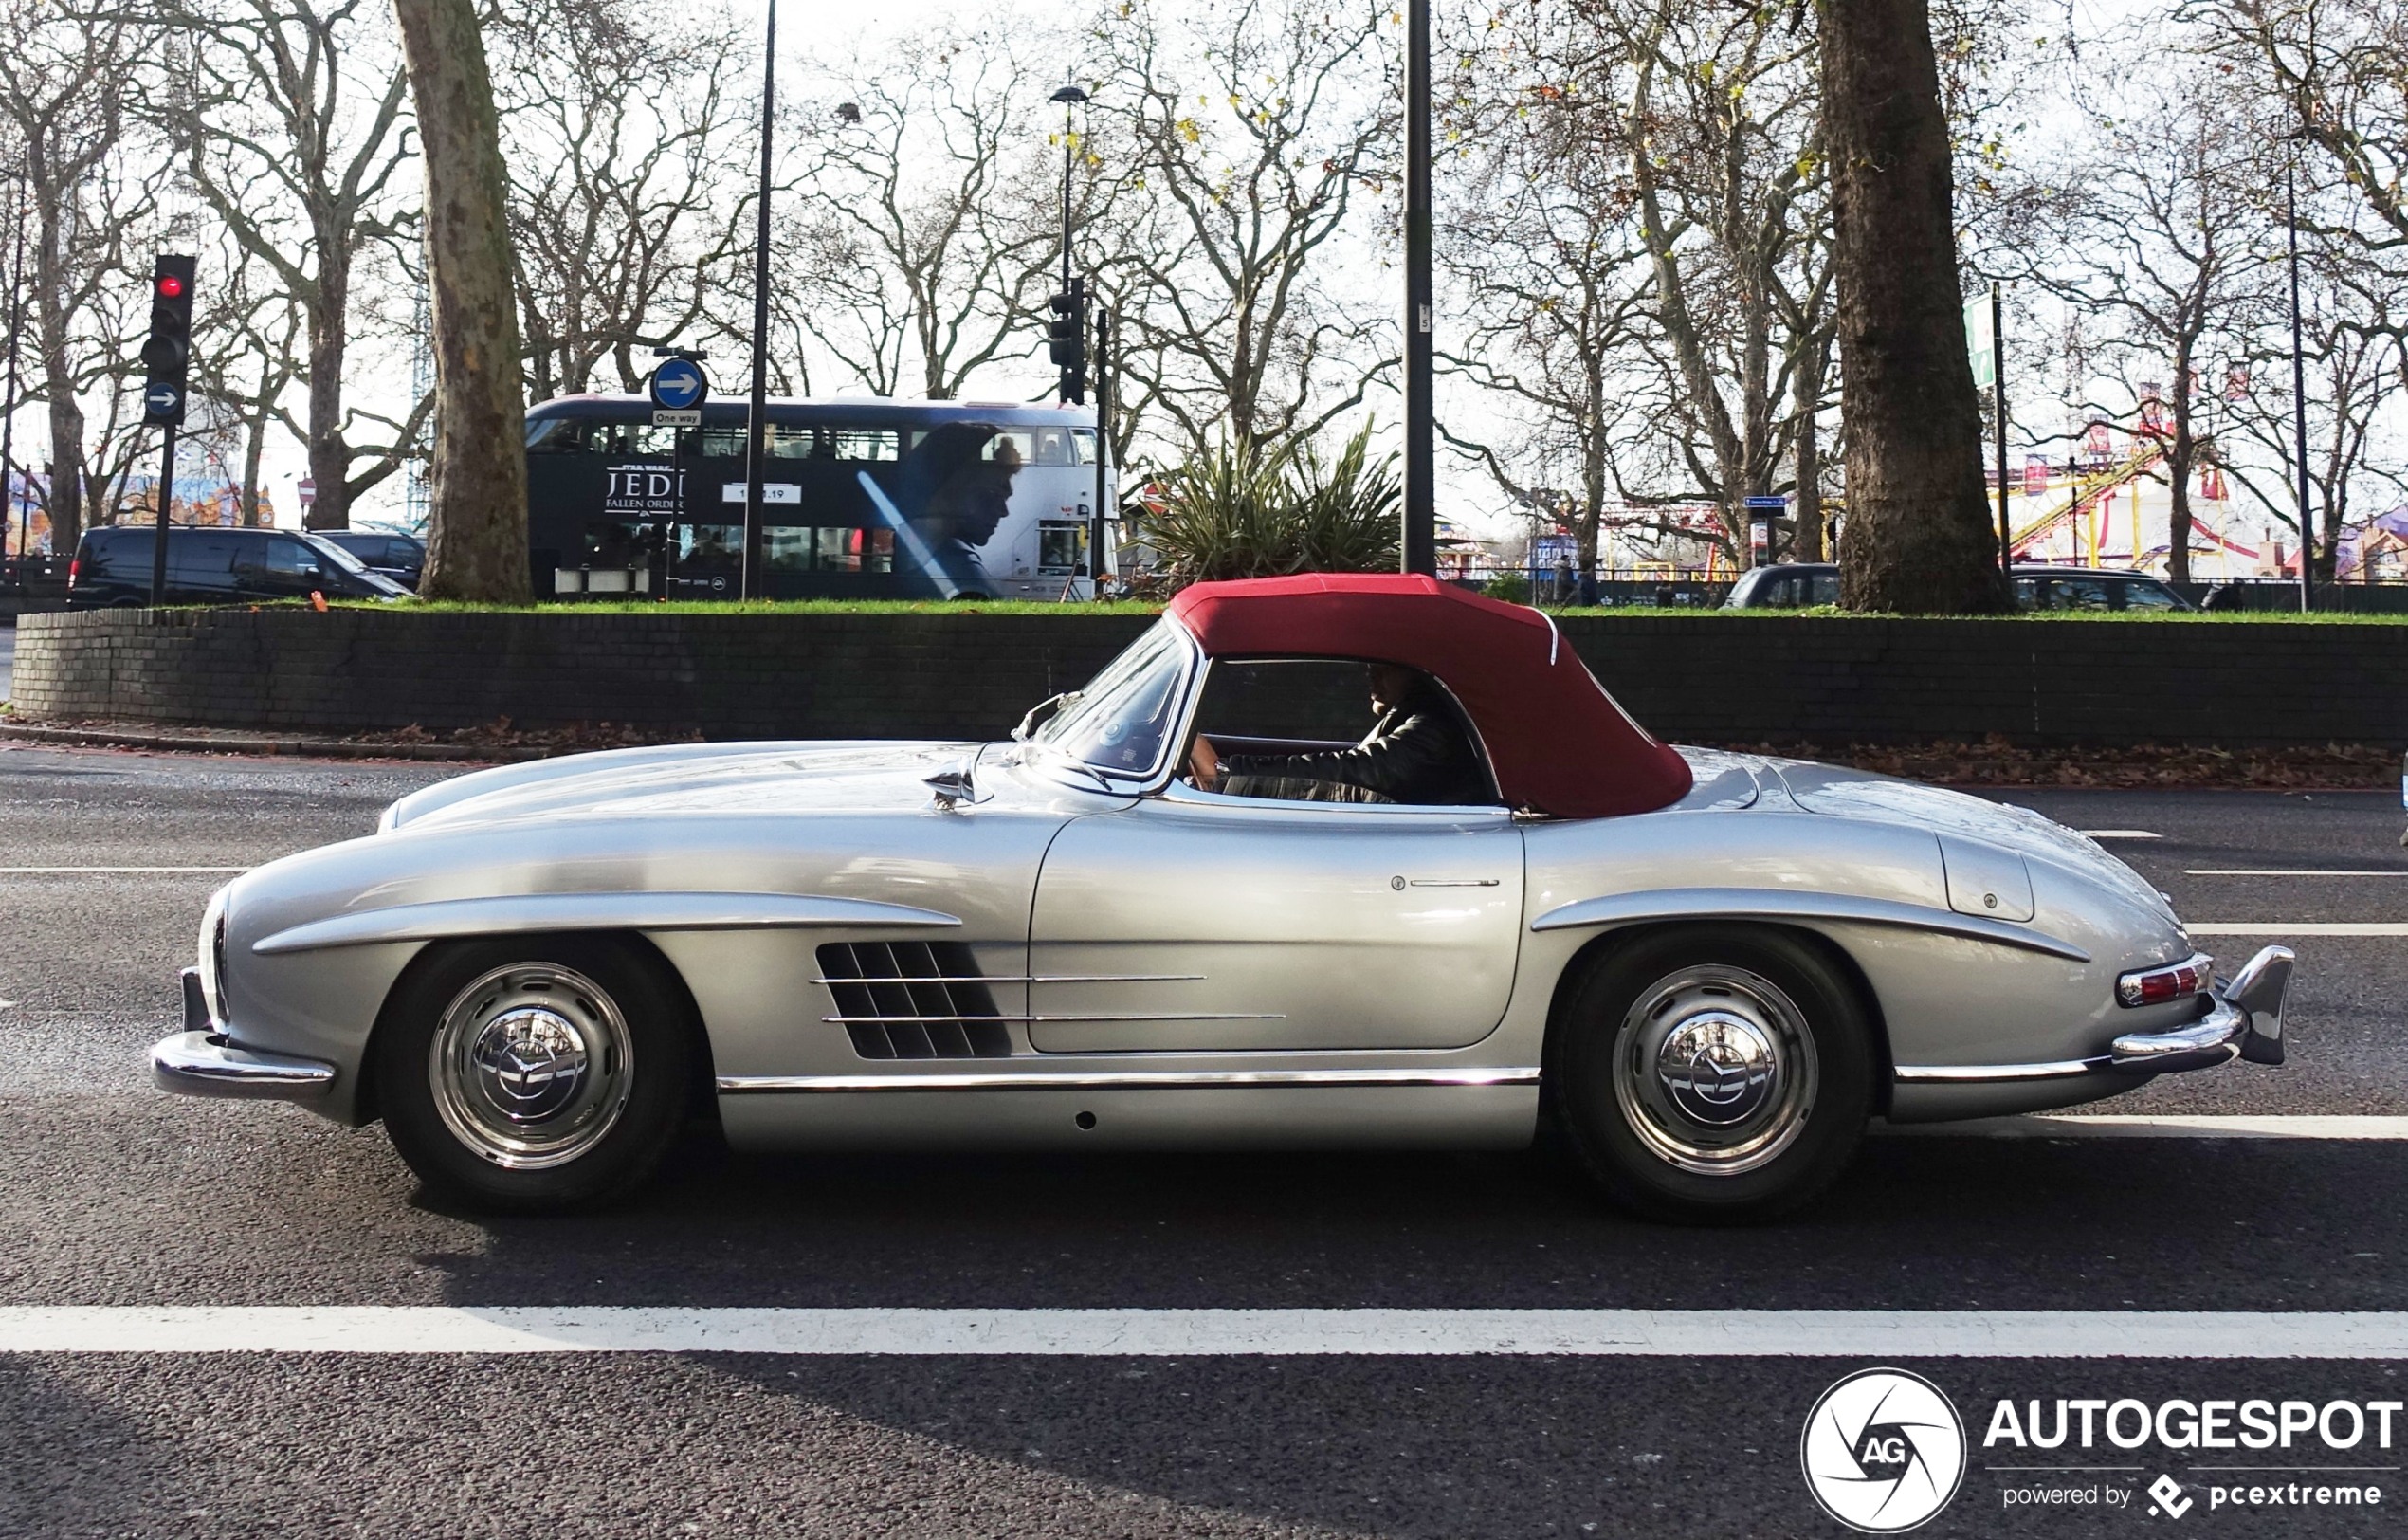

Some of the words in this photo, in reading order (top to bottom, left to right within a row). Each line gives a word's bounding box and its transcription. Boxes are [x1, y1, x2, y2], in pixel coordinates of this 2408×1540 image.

[656, 413, 676, 423] One
[679, 415, 698, 424] way
[607, 473, 684, 498] JEDI
[606, 499, 644, 508] FALLEN
